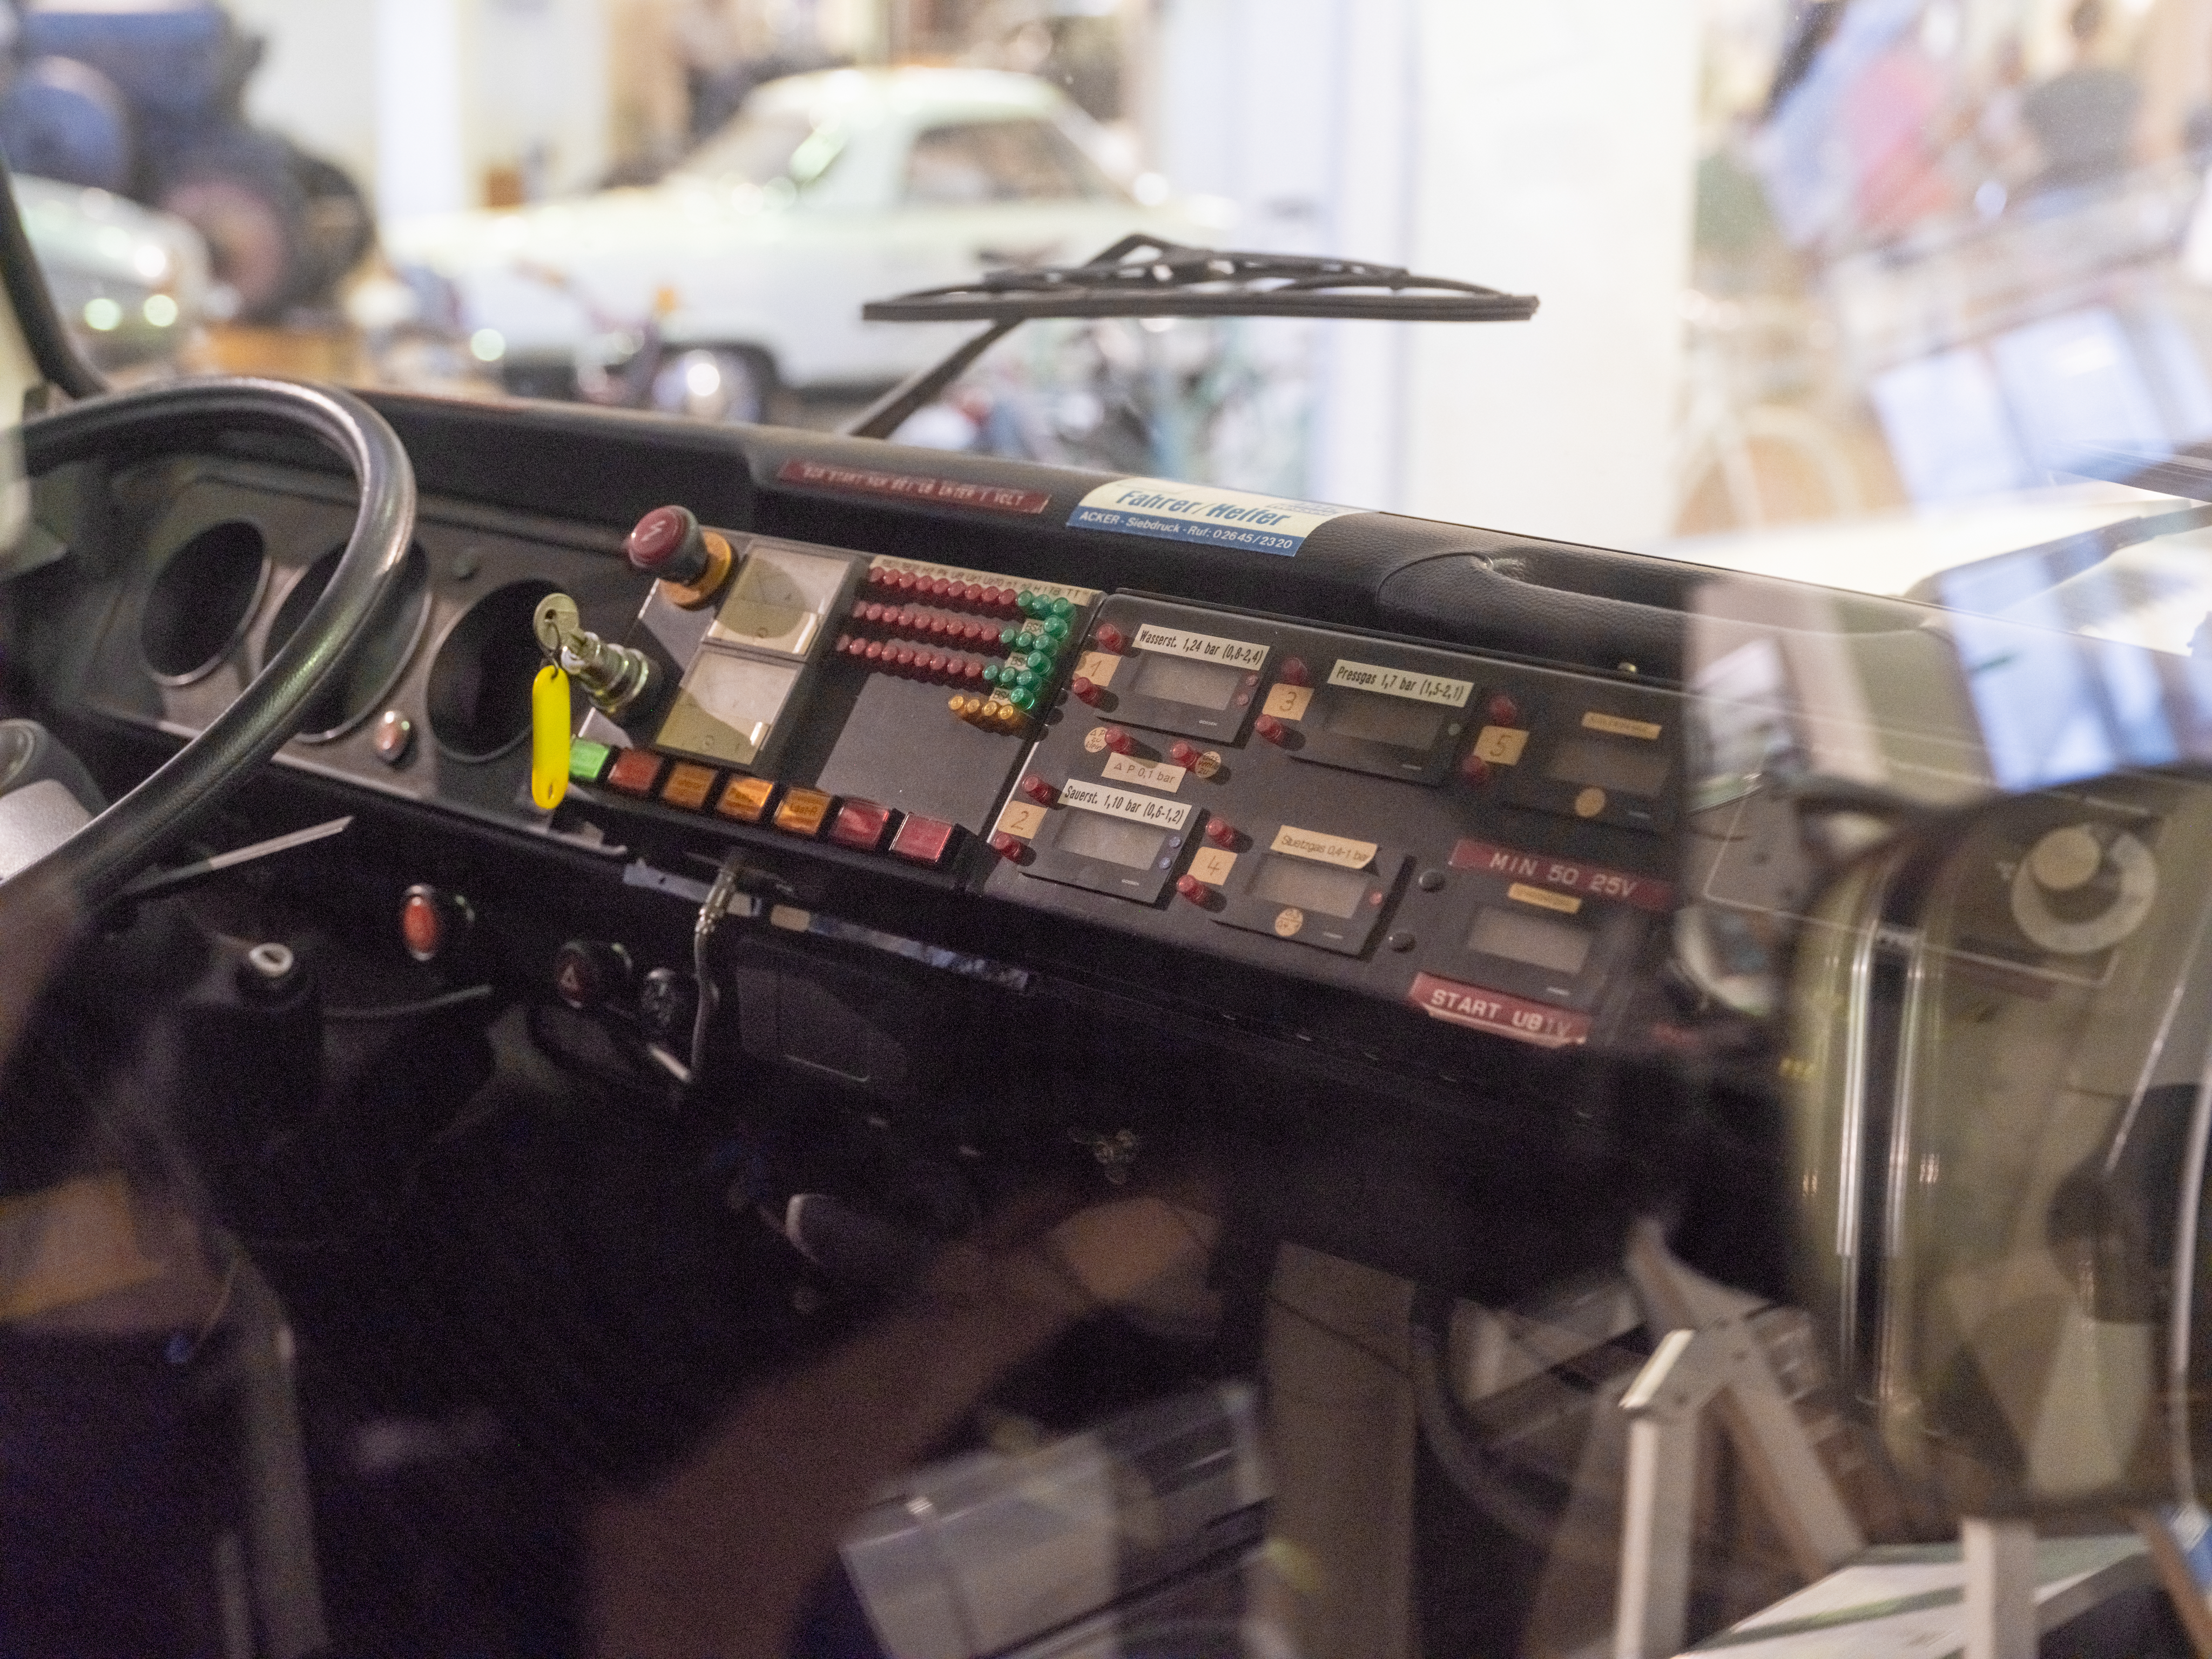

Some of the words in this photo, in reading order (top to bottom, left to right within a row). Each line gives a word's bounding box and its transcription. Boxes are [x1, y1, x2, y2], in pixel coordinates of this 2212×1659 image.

[1079, 511, 1118, 525] ACKER
[1126, 516, 1180, 534] Siebdruck
[1188, 525, 1212, 537] Ruf:
[1213, 529, 1293, 549] 02645/2320
[1139, 630, 1177, 648] Wasserst.
[1183, 637, 1202, 652] 1,24
[1204, 642, 1220, 656] bar
[1222, 644, 1264, 665] (0,8-2,4)
[1090, 659, 1103, 677] 1
[1336, 665, 1377, 685] Pressgas
[1381, 673, 1398, 690] 1,7
[1400, 677, 1416, 692] bar
[1418, 679, 1465, 702] (1,5-2,1)
[1279, 691, 1297, 711] 3
[1489, 736, 1510, 757] 5
[1137, 767, 1153, 779] 0,1
[1157, 771, 1176, 783] bar
[1064, 785, 1098, 804] Sauerst.
[1104, 794, 1123, 810] 1,10
[1125, 798, 1141, 812] bar
[1143, 803, 1184, 825] (0,6-1,2)
[1010, 811, 1030, 831] 2
[1206, 855, 1220, 875] 4
[1489, 852, 1539, 876] MIN
[1547, 864, 1580, 885] 50
[1431, 988, 1502, 1020] START
